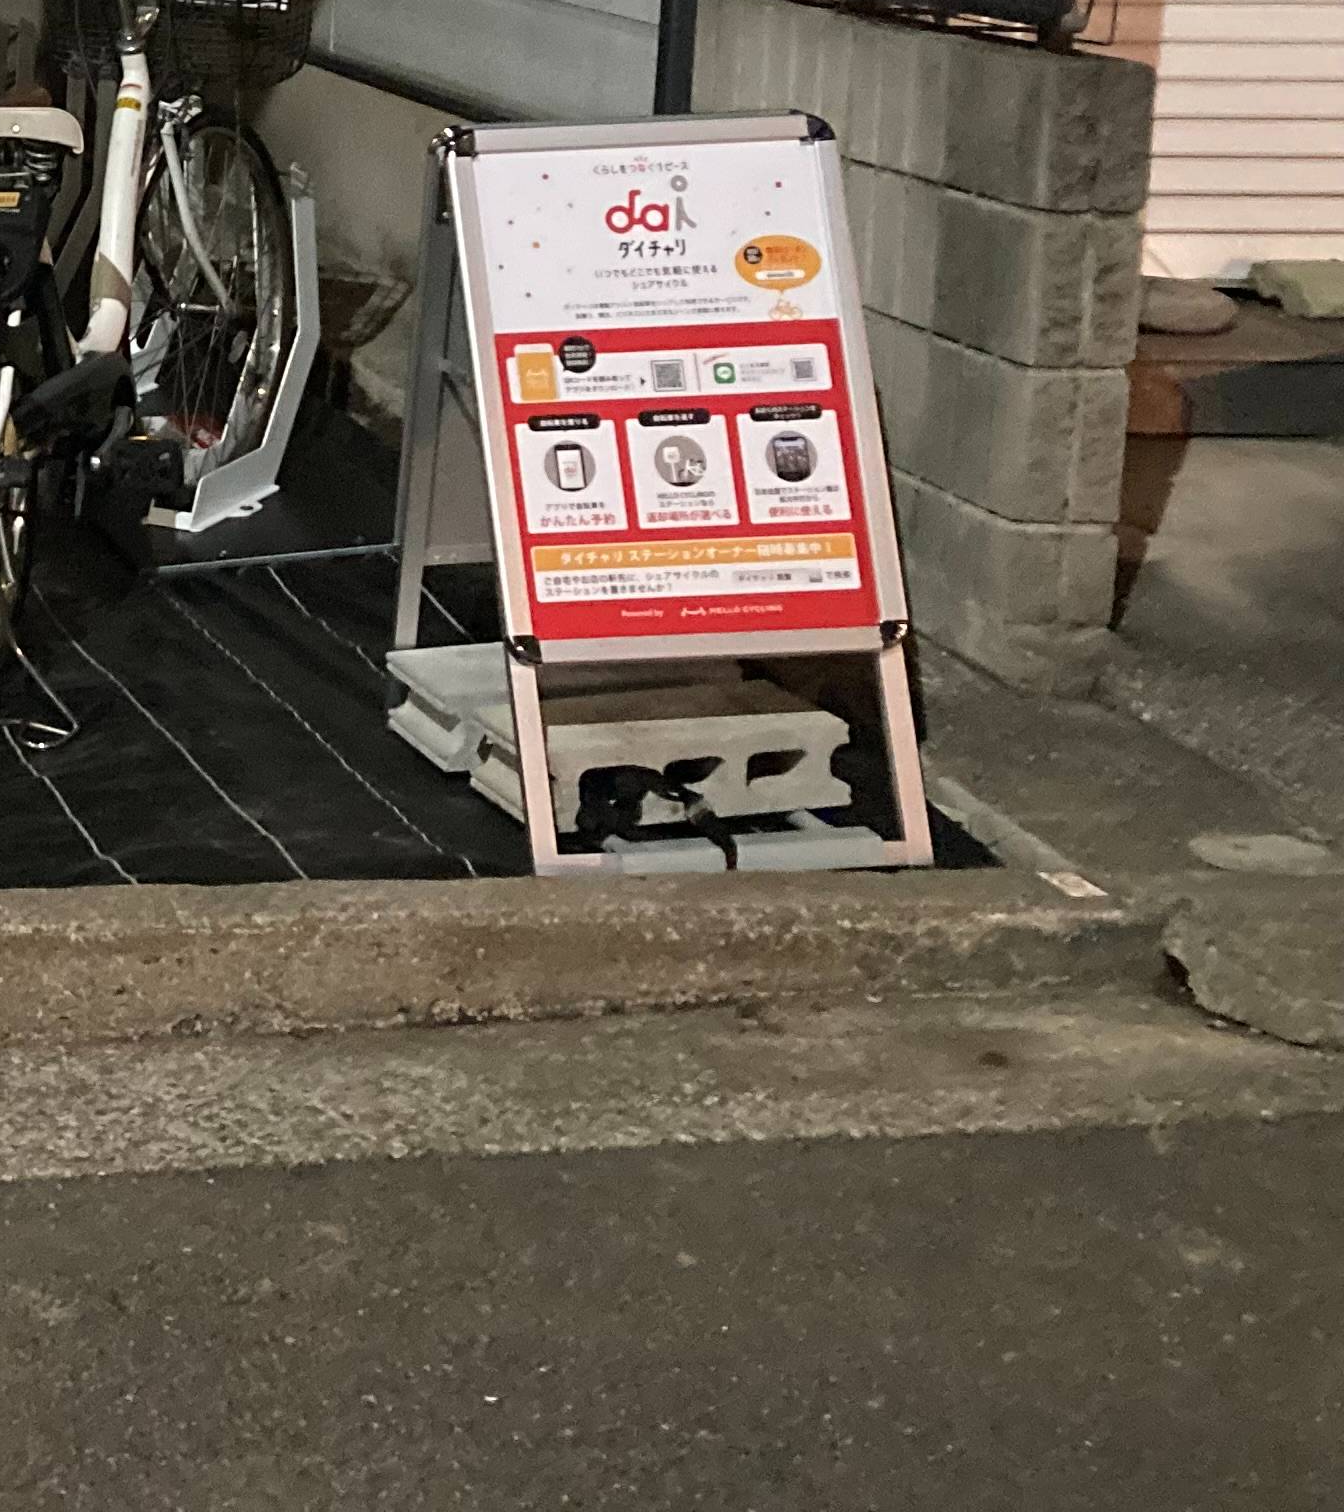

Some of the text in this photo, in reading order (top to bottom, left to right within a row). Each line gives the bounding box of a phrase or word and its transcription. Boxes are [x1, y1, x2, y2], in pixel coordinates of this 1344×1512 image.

[592, 161, 689, 175] くらしをつなぐ1ピース
[605, 175, 697, 234] dai
[617, 238, 687, 259] ダイチャリ
[593, 264, 718, 279] いつでもどこでも気軽に使える
[631, 279, 688, 290] シェアサイクル
[768, 504, 832, 517] 便利に使える
[539, 512, 616, 527] かんたん予約
[559, 550, 624, 565] ダイチャリ
